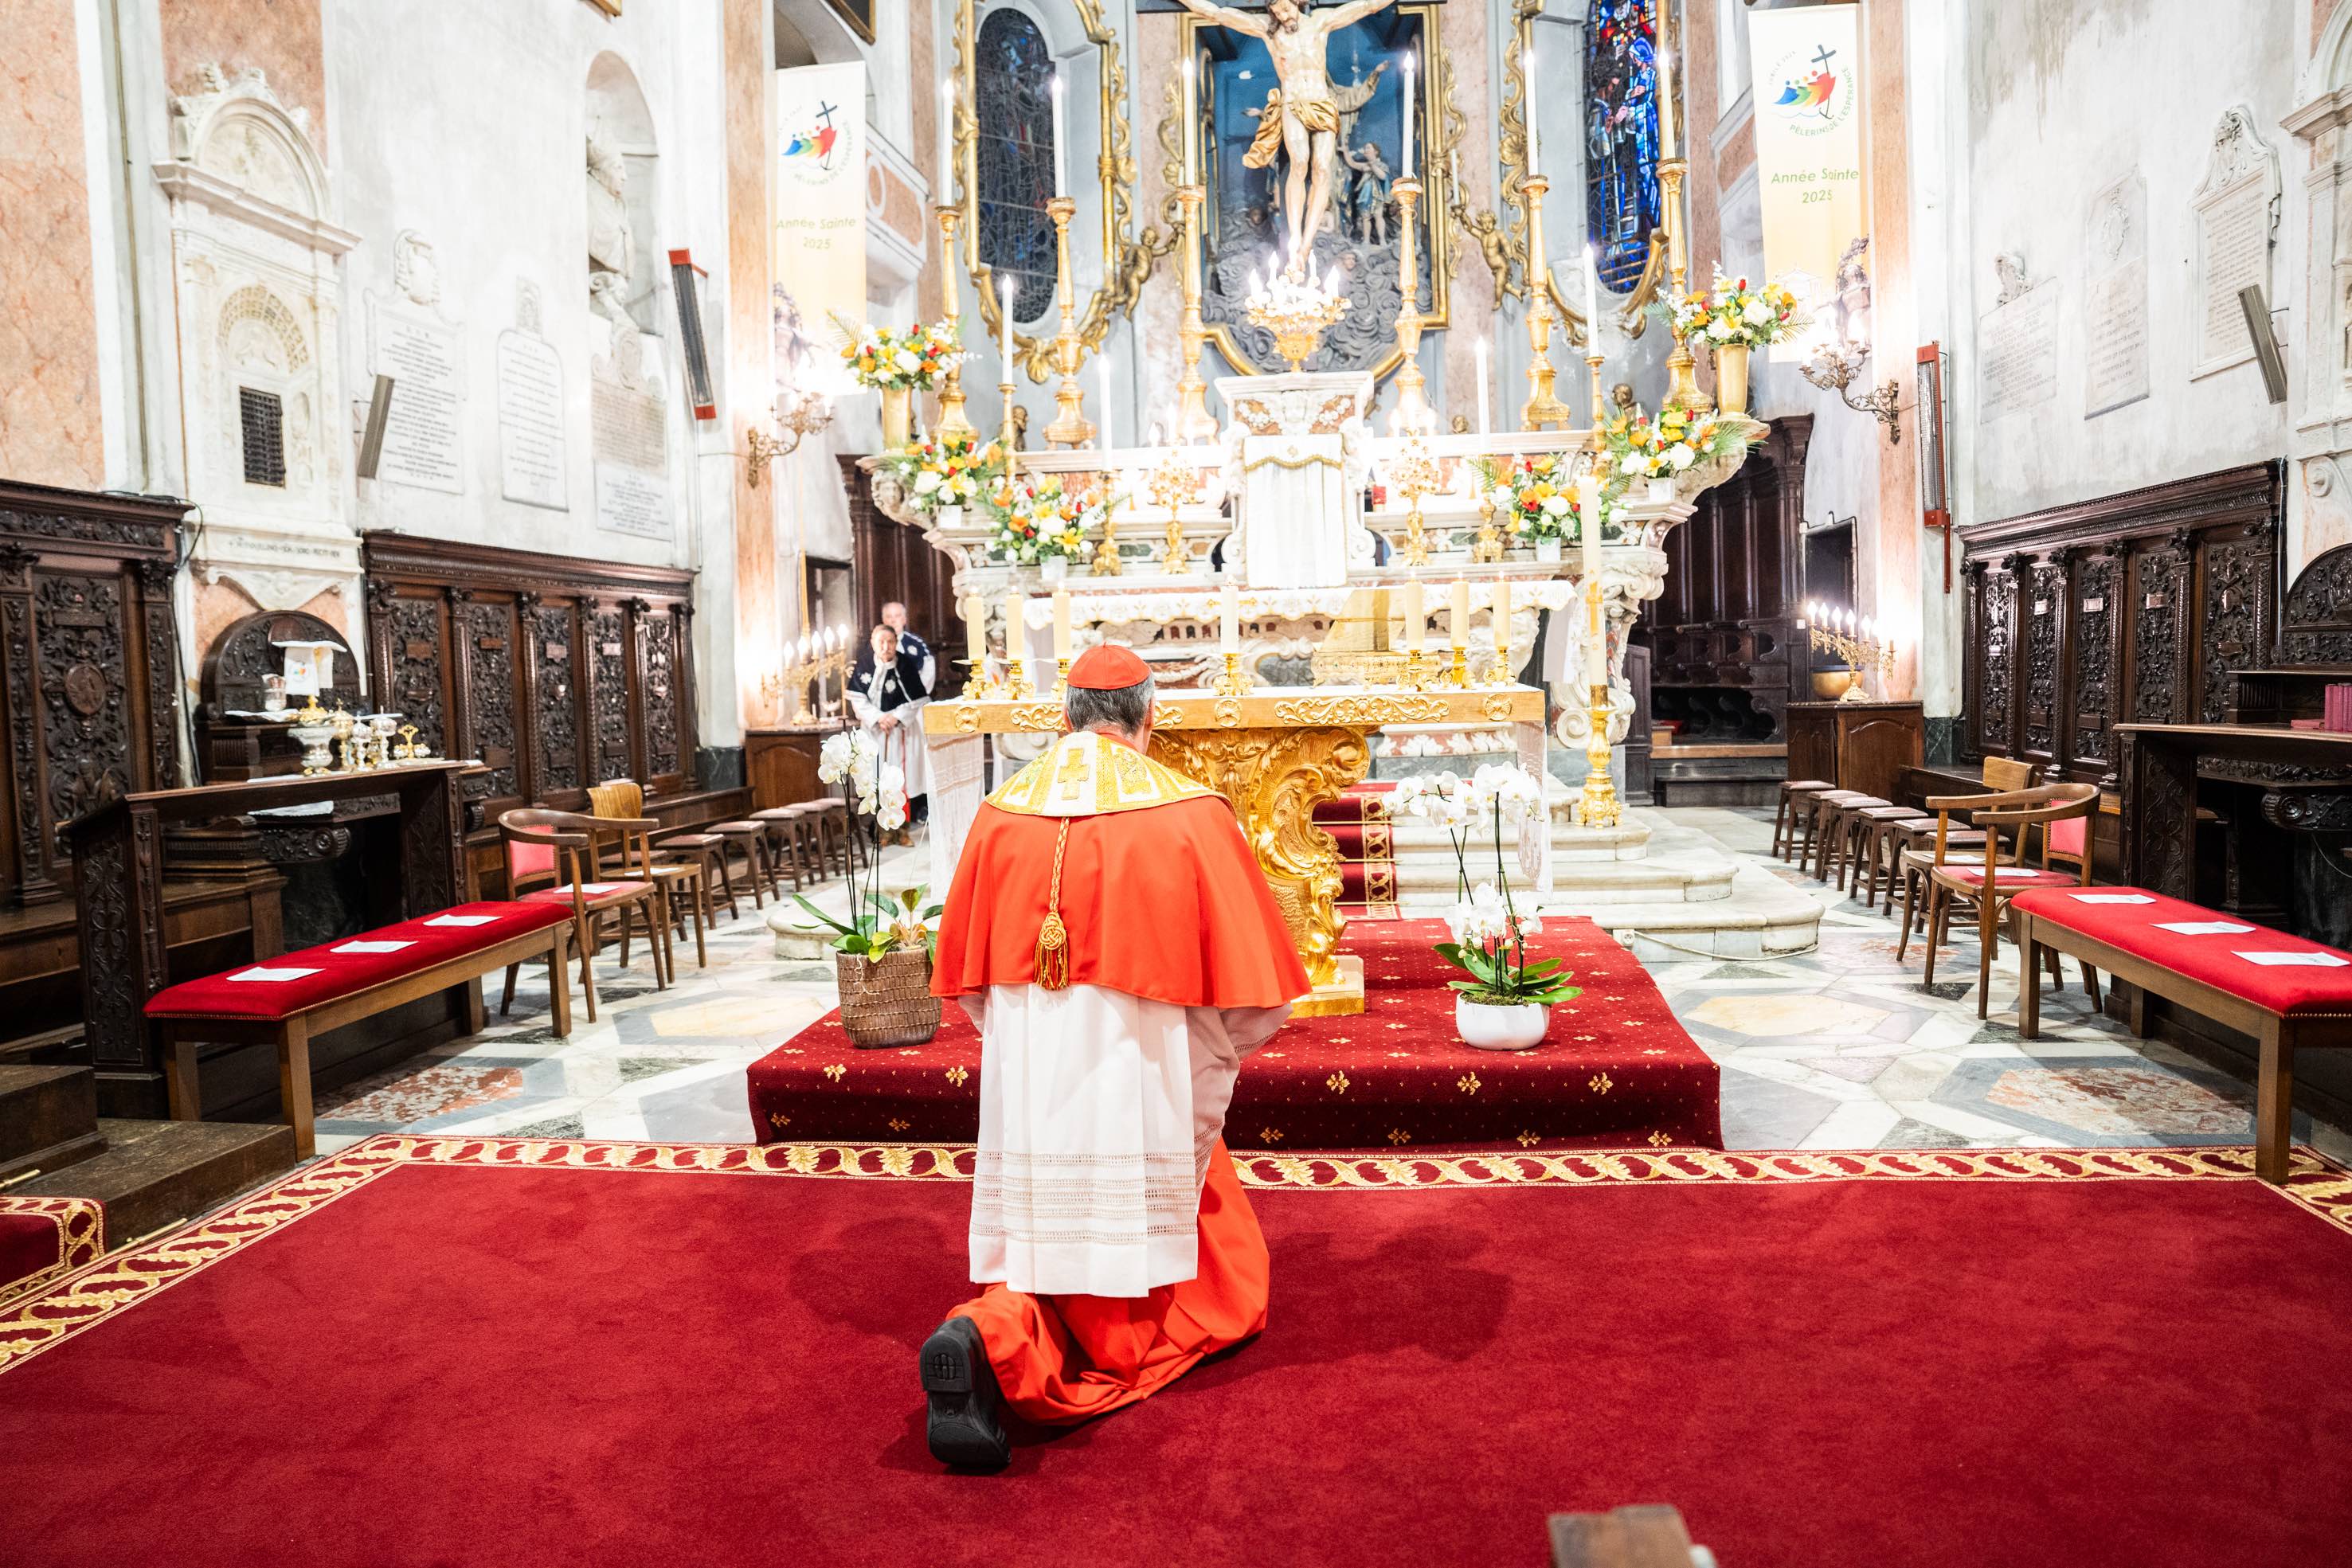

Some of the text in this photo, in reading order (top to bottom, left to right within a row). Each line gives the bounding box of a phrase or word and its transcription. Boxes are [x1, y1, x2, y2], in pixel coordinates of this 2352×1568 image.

[1771, 167, 1860, 185] Année Sainte
[1802, 190, 1833, 205] 2025
[777, 217, 856, 229] Année Sainte
[803, 237, 832, 249] 2025
